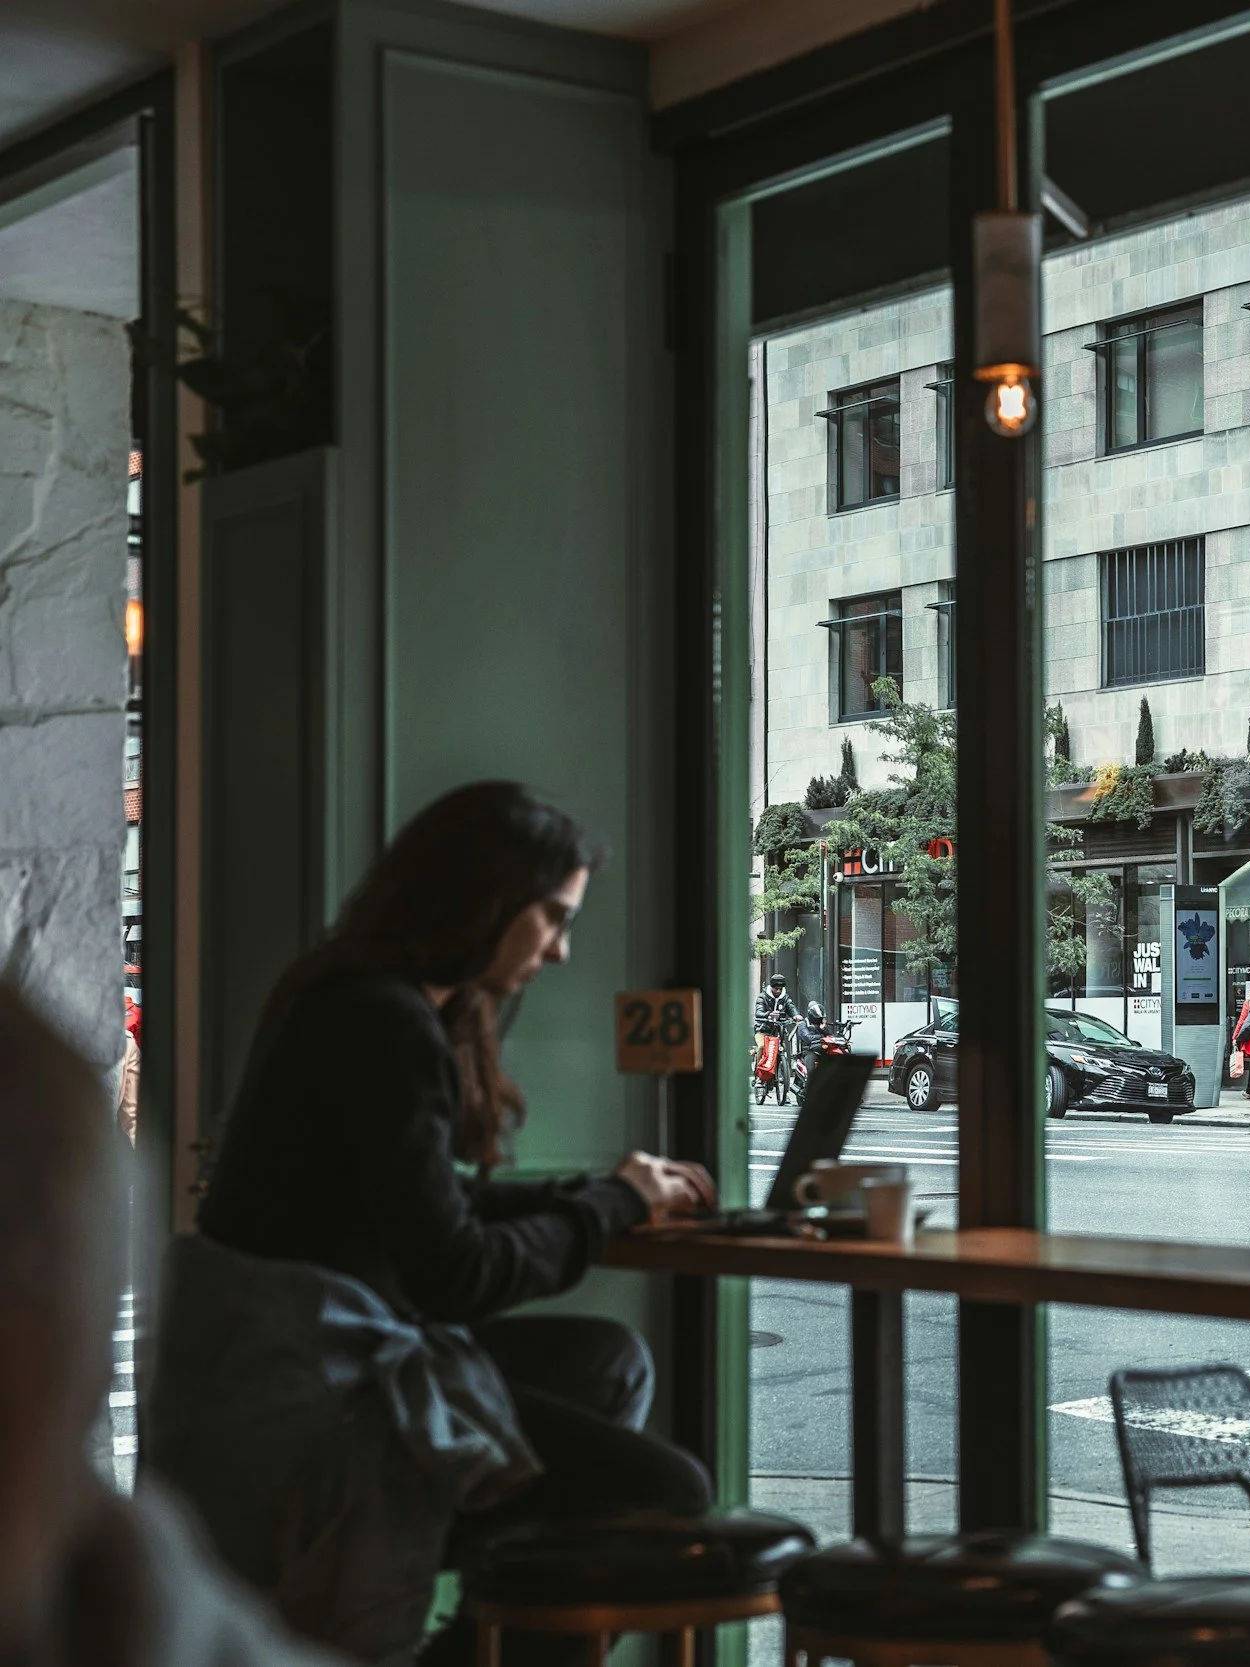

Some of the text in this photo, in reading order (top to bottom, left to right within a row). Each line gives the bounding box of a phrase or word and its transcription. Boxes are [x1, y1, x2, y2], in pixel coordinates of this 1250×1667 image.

[1133, 942, 1161, 958] JUS
[1133, 957, 1161, 973] WAL
[1133, 972, 1147, 988] IN
[853, 1005, 877, 1013] CITYMD
[1140, 999, 1161, 1008] CITYM
[623, 1000, 690, 1046] 28
